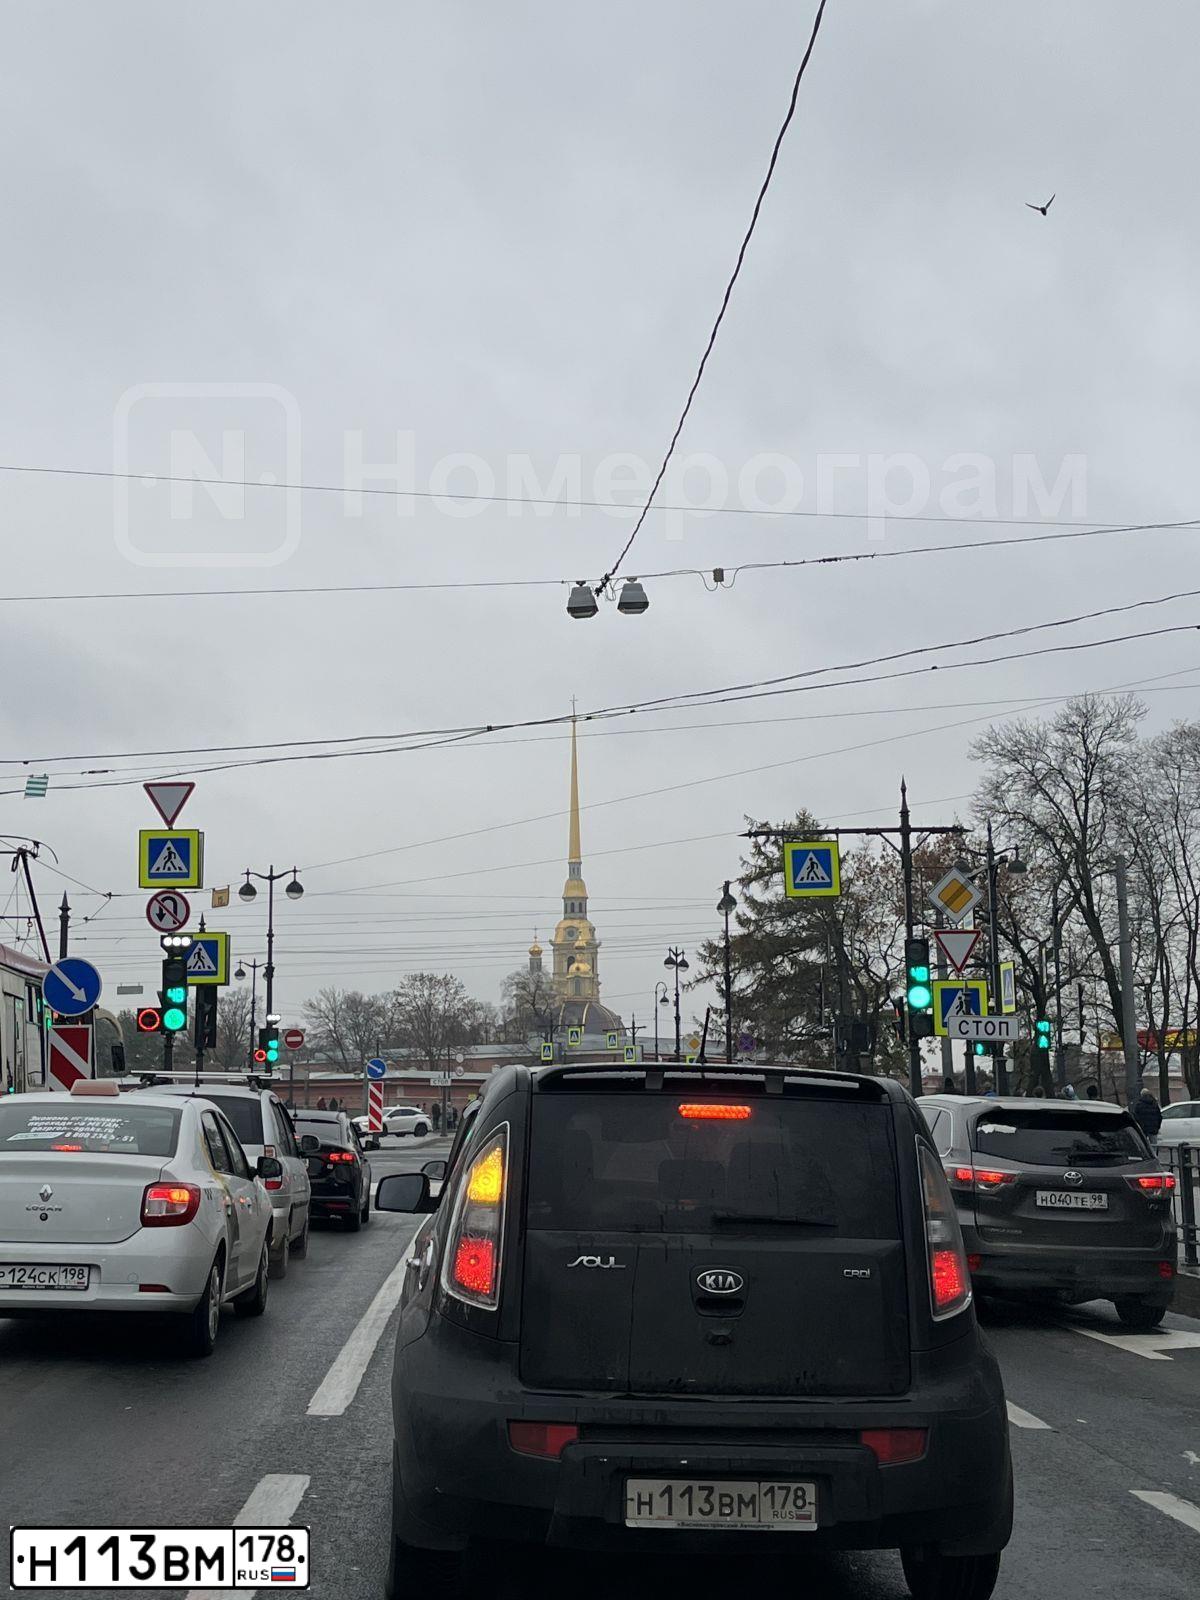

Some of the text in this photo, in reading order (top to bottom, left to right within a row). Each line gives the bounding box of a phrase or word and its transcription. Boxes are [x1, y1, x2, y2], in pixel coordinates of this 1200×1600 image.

[958, 1019, 1010, 1036] СТОП
[1040, 1193, 1088, 1206] Н040ТЕ
[567, 1255, 626, 1268] SOUL
[61, 1267, 86, 1280] 198
[704, 1275, 737, 1290] KIA
[636, 1484, 808, 1518] Н113ВМ 178
[772, 1510, 796, 1520] RUS
